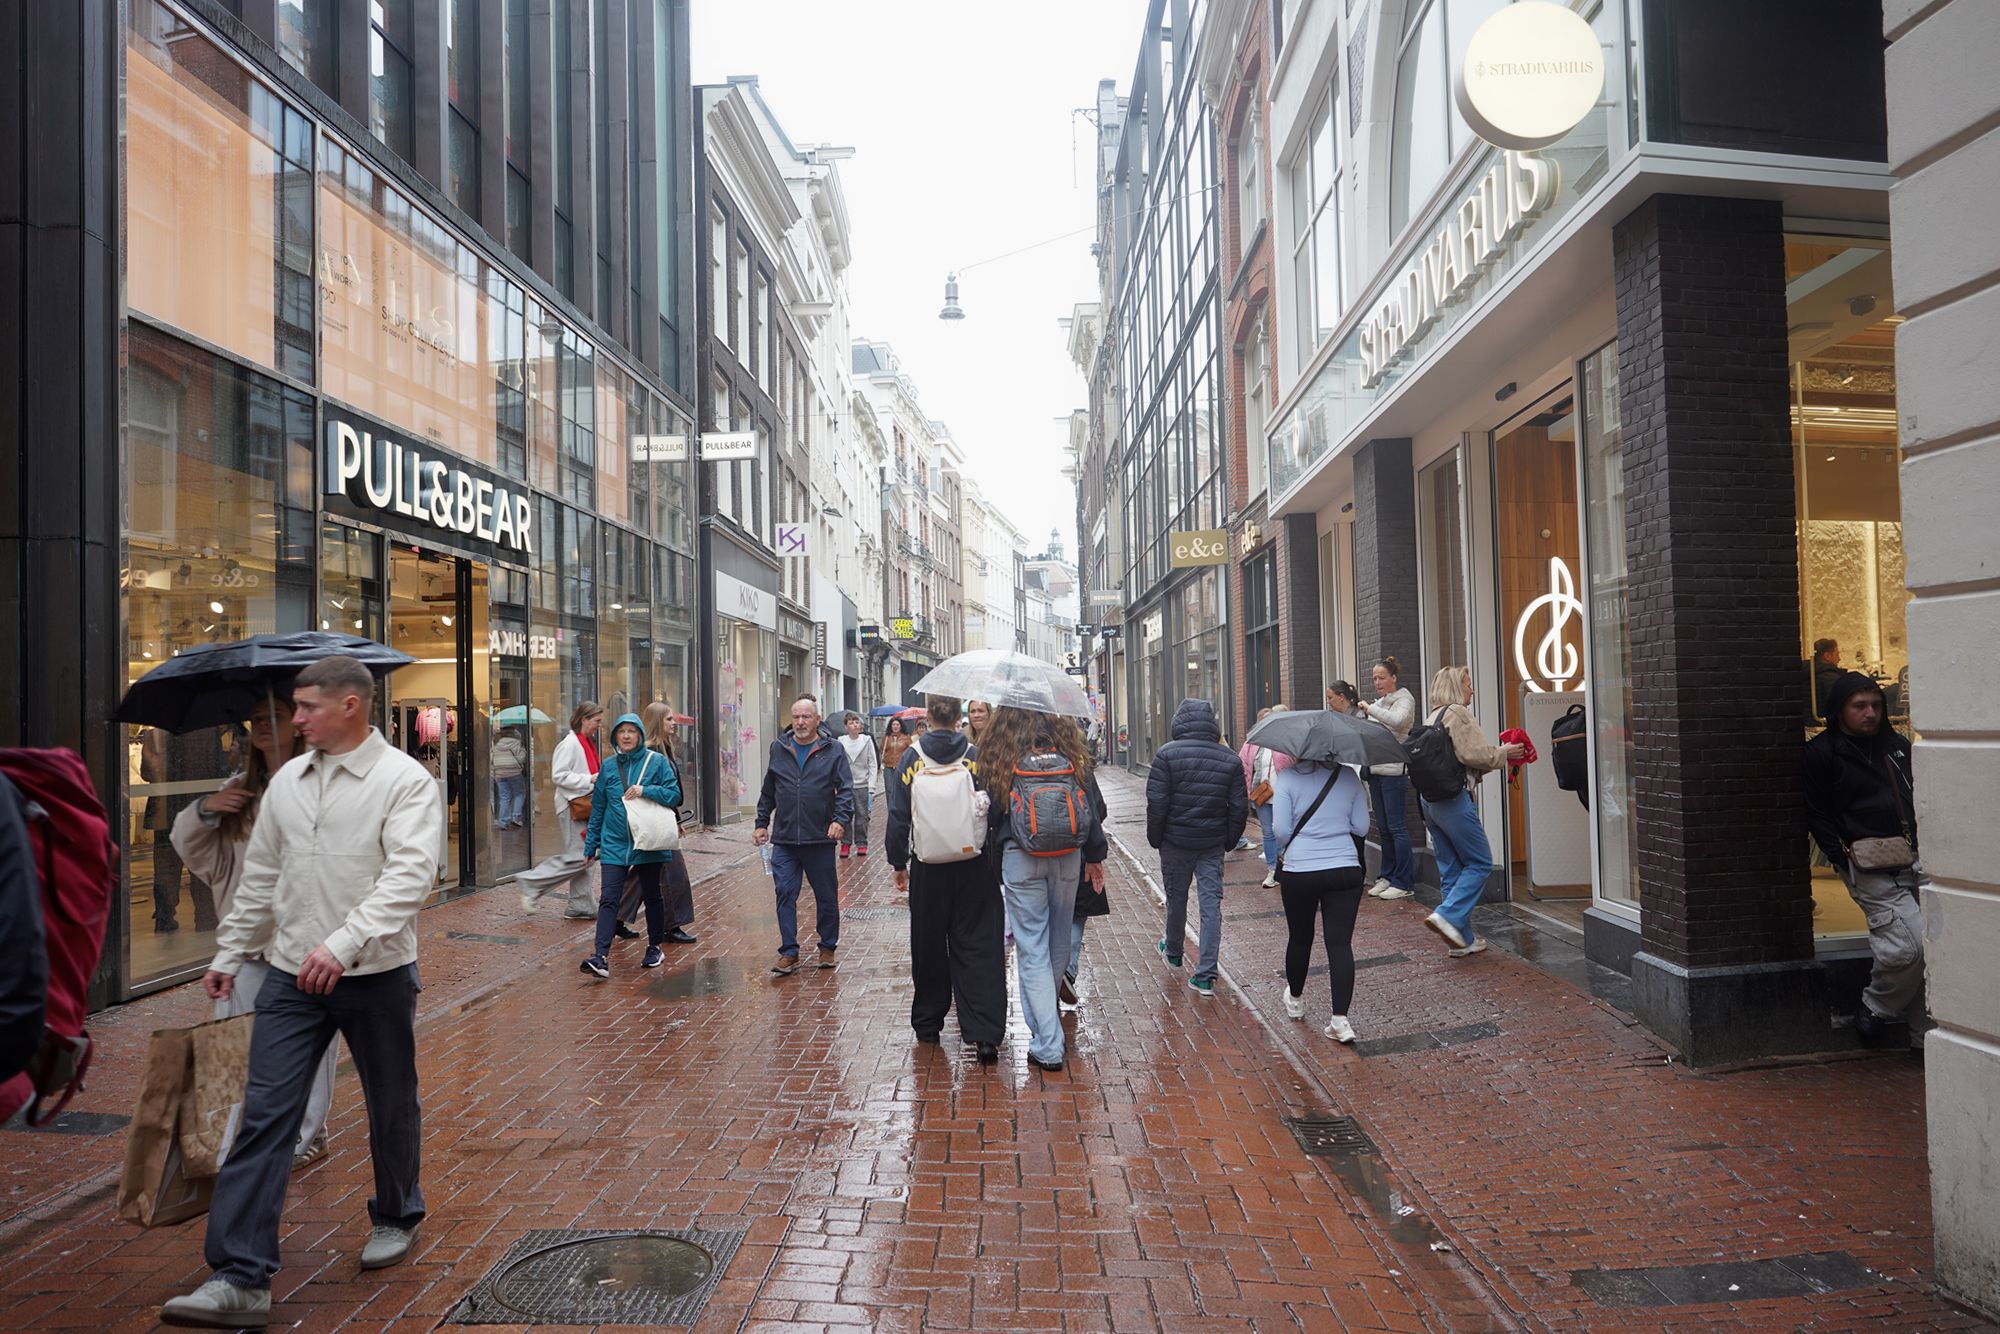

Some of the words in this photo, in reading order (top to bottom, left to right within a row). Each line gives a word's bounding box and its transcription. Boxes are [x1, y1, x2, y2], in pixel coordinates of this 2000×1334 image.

[1489, 61, 1594, 77] STRADIVARIUS
[1360, 150, 1562, 390] STRADIVARIUS
[705, 440, 752, 450] PULL&BEAR
[334, 420, 532, 553] PULL&BEAR
[1175, 537, 1224, 559] e&e
[739, 584, 760, 612] KIKO
[817, 623, 825, 665] MANFIELD
